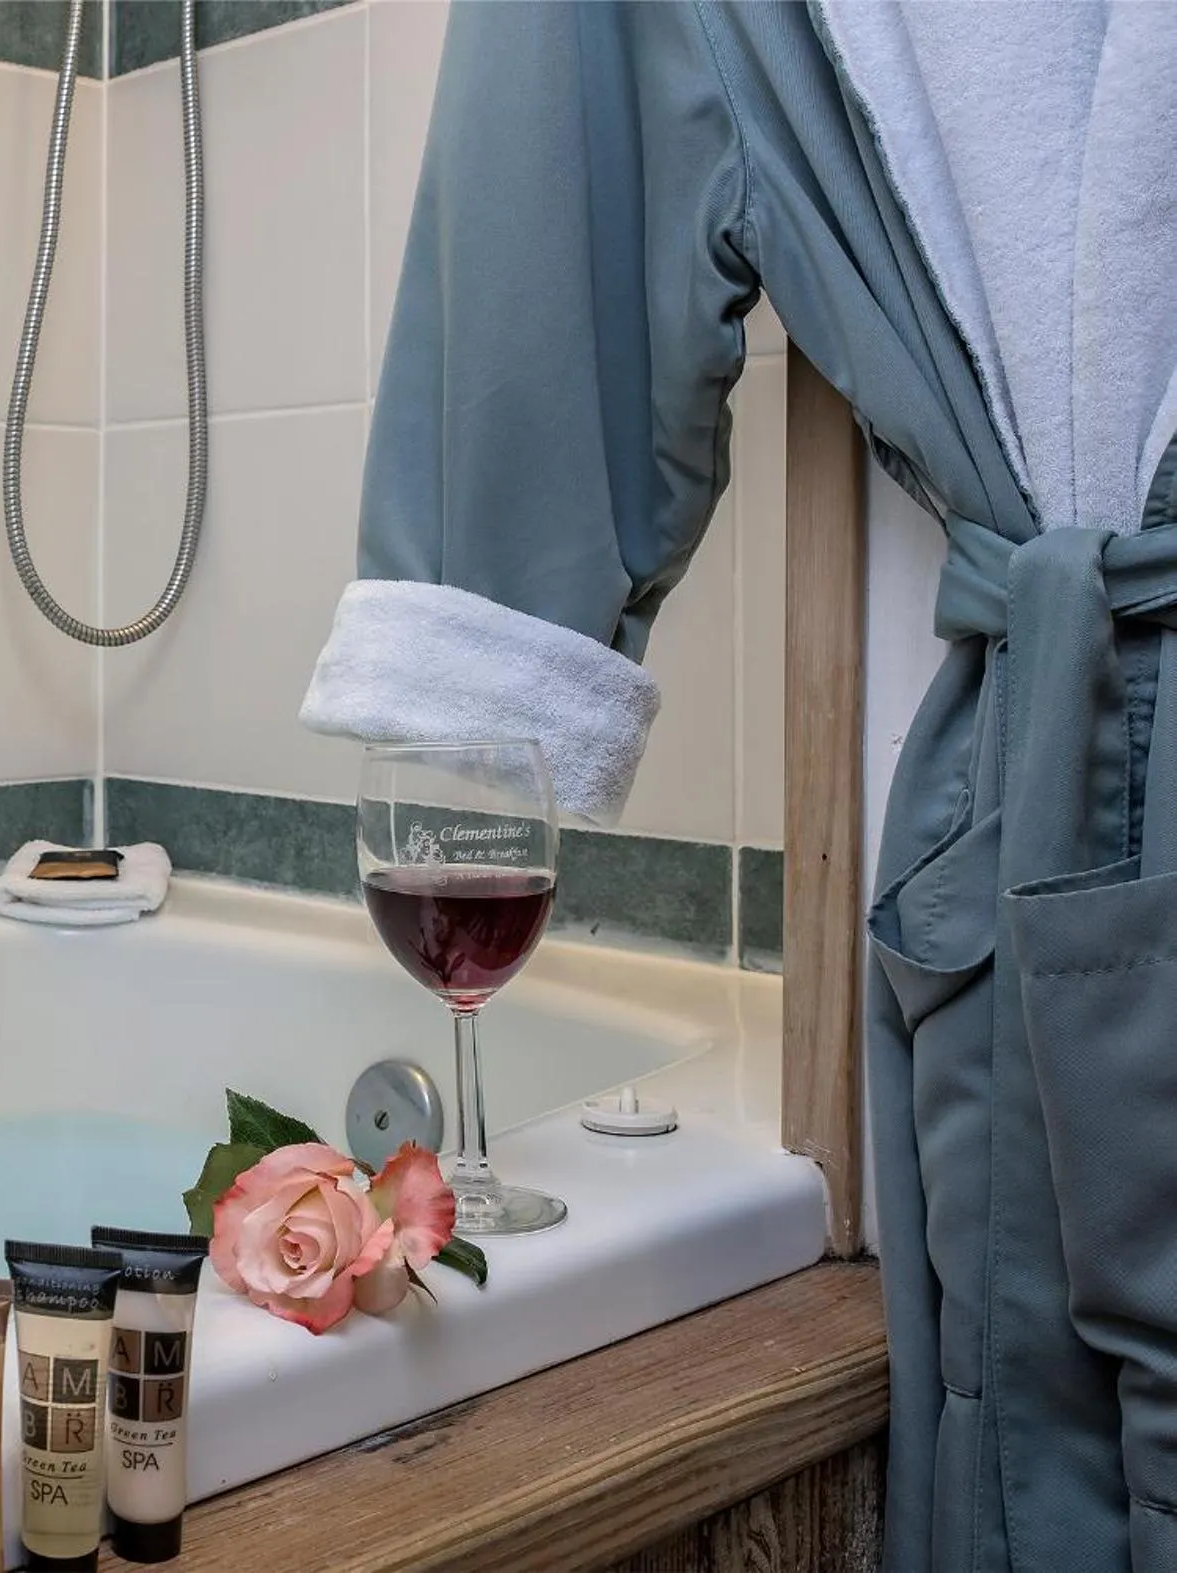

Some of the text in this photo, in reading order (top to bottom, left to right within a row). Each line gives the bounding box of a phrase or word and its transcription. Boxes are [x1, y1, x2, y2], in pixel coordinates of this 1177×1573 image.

[440, 822, 531, 841] Clementine's
[124, 1265, 175, 1281] otion
[110, 1421, 177, 1441] Green Tea
[62, 1460, 87, 1473] Tea
[122, 1450, 160, 1472] SPA
[30, 1479, 69, 1506] SPA
